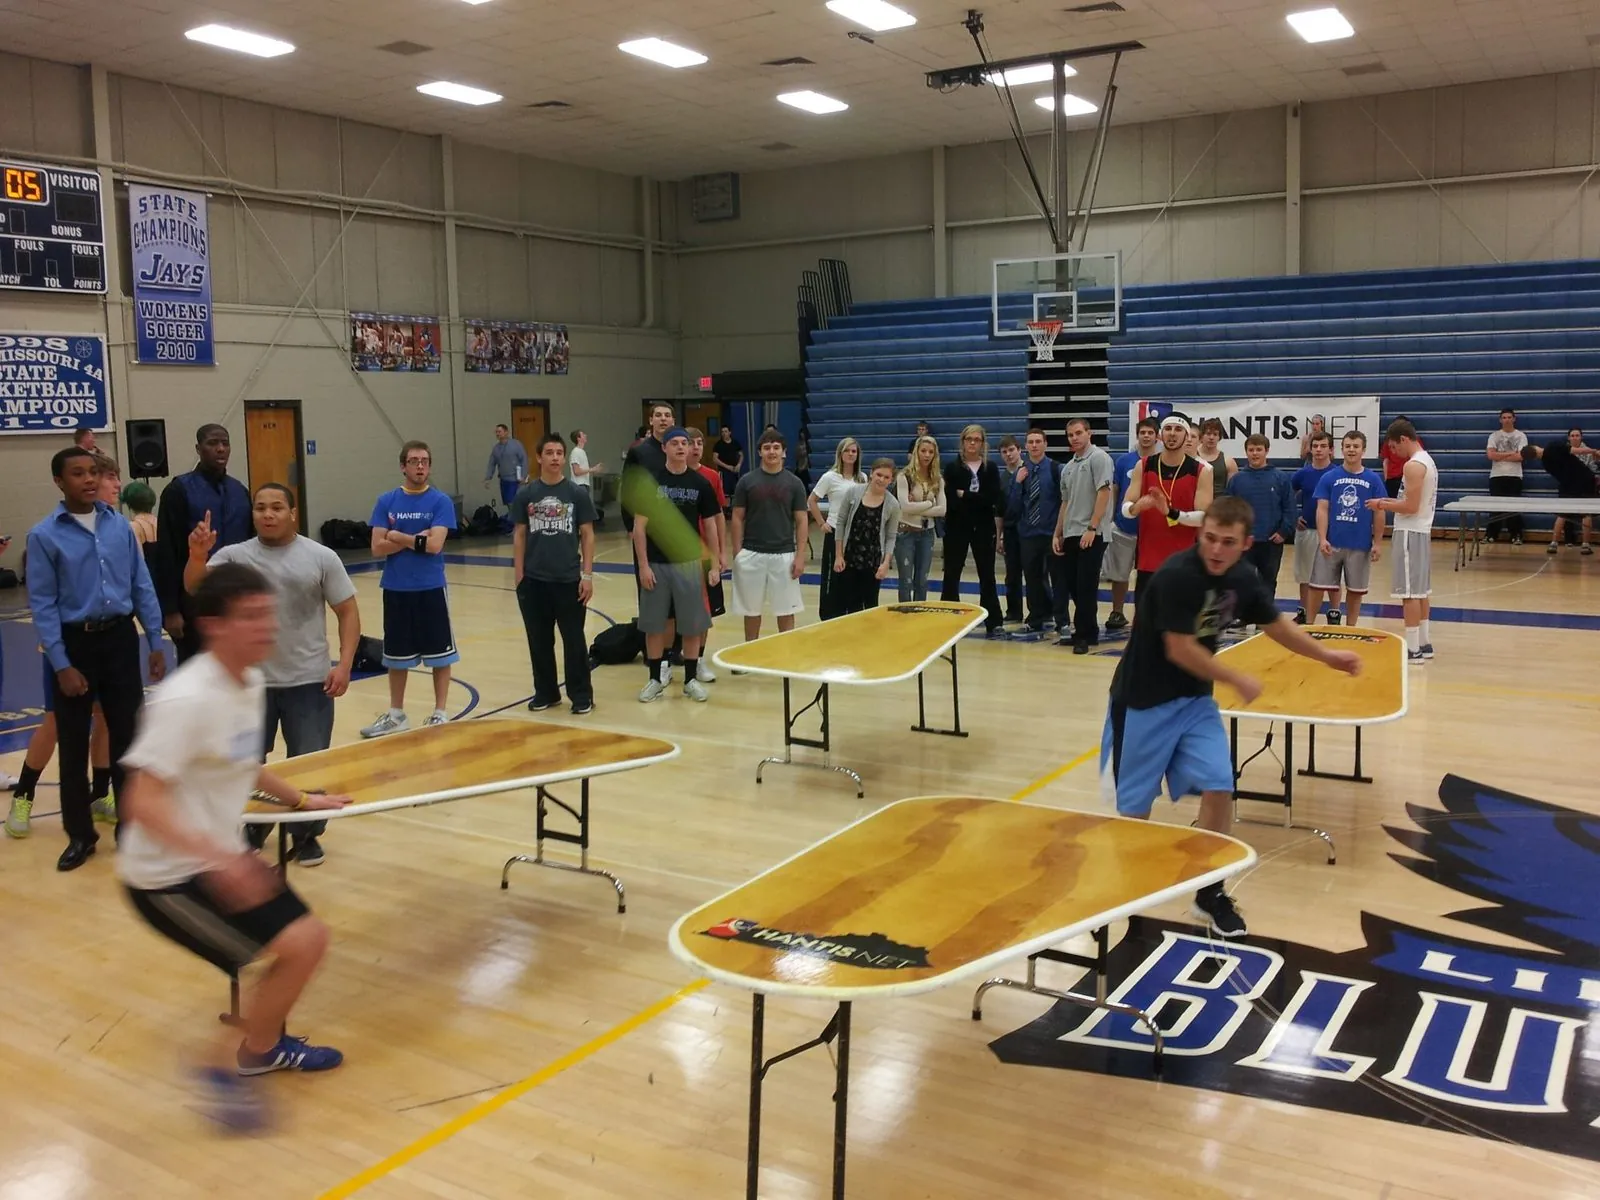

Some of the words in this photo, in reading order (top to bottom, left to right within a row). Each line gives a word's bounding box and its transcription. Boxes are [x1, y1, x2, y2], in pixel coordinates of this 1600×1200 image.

[6, 168, 40, 200] 05
[49, 173, 98, 192] VISITOR
[138, 194, 198, 222] STATE
[51, 225, 82, 237] BONUS
[133, 217, 206, 256] CHAMPIONS
[14, 239, 44, 251] FOULS
[71, 245, 99, 256] FOULS
[44, 277, 62, 288] TOL
[73, 279, 102, 290] POINTS
[139, 300, 207, 321] WOMENS
[146, 321, 204, 340] SOCCER
[157, 341, 196, 359] 2010
[83, 364, 103, 382] 4A
[0, 399, 98, 415] MPIONS
[1333, 477, 1370, 489] JUNIORS
[1057, 930, 1600, 1128] BLU
